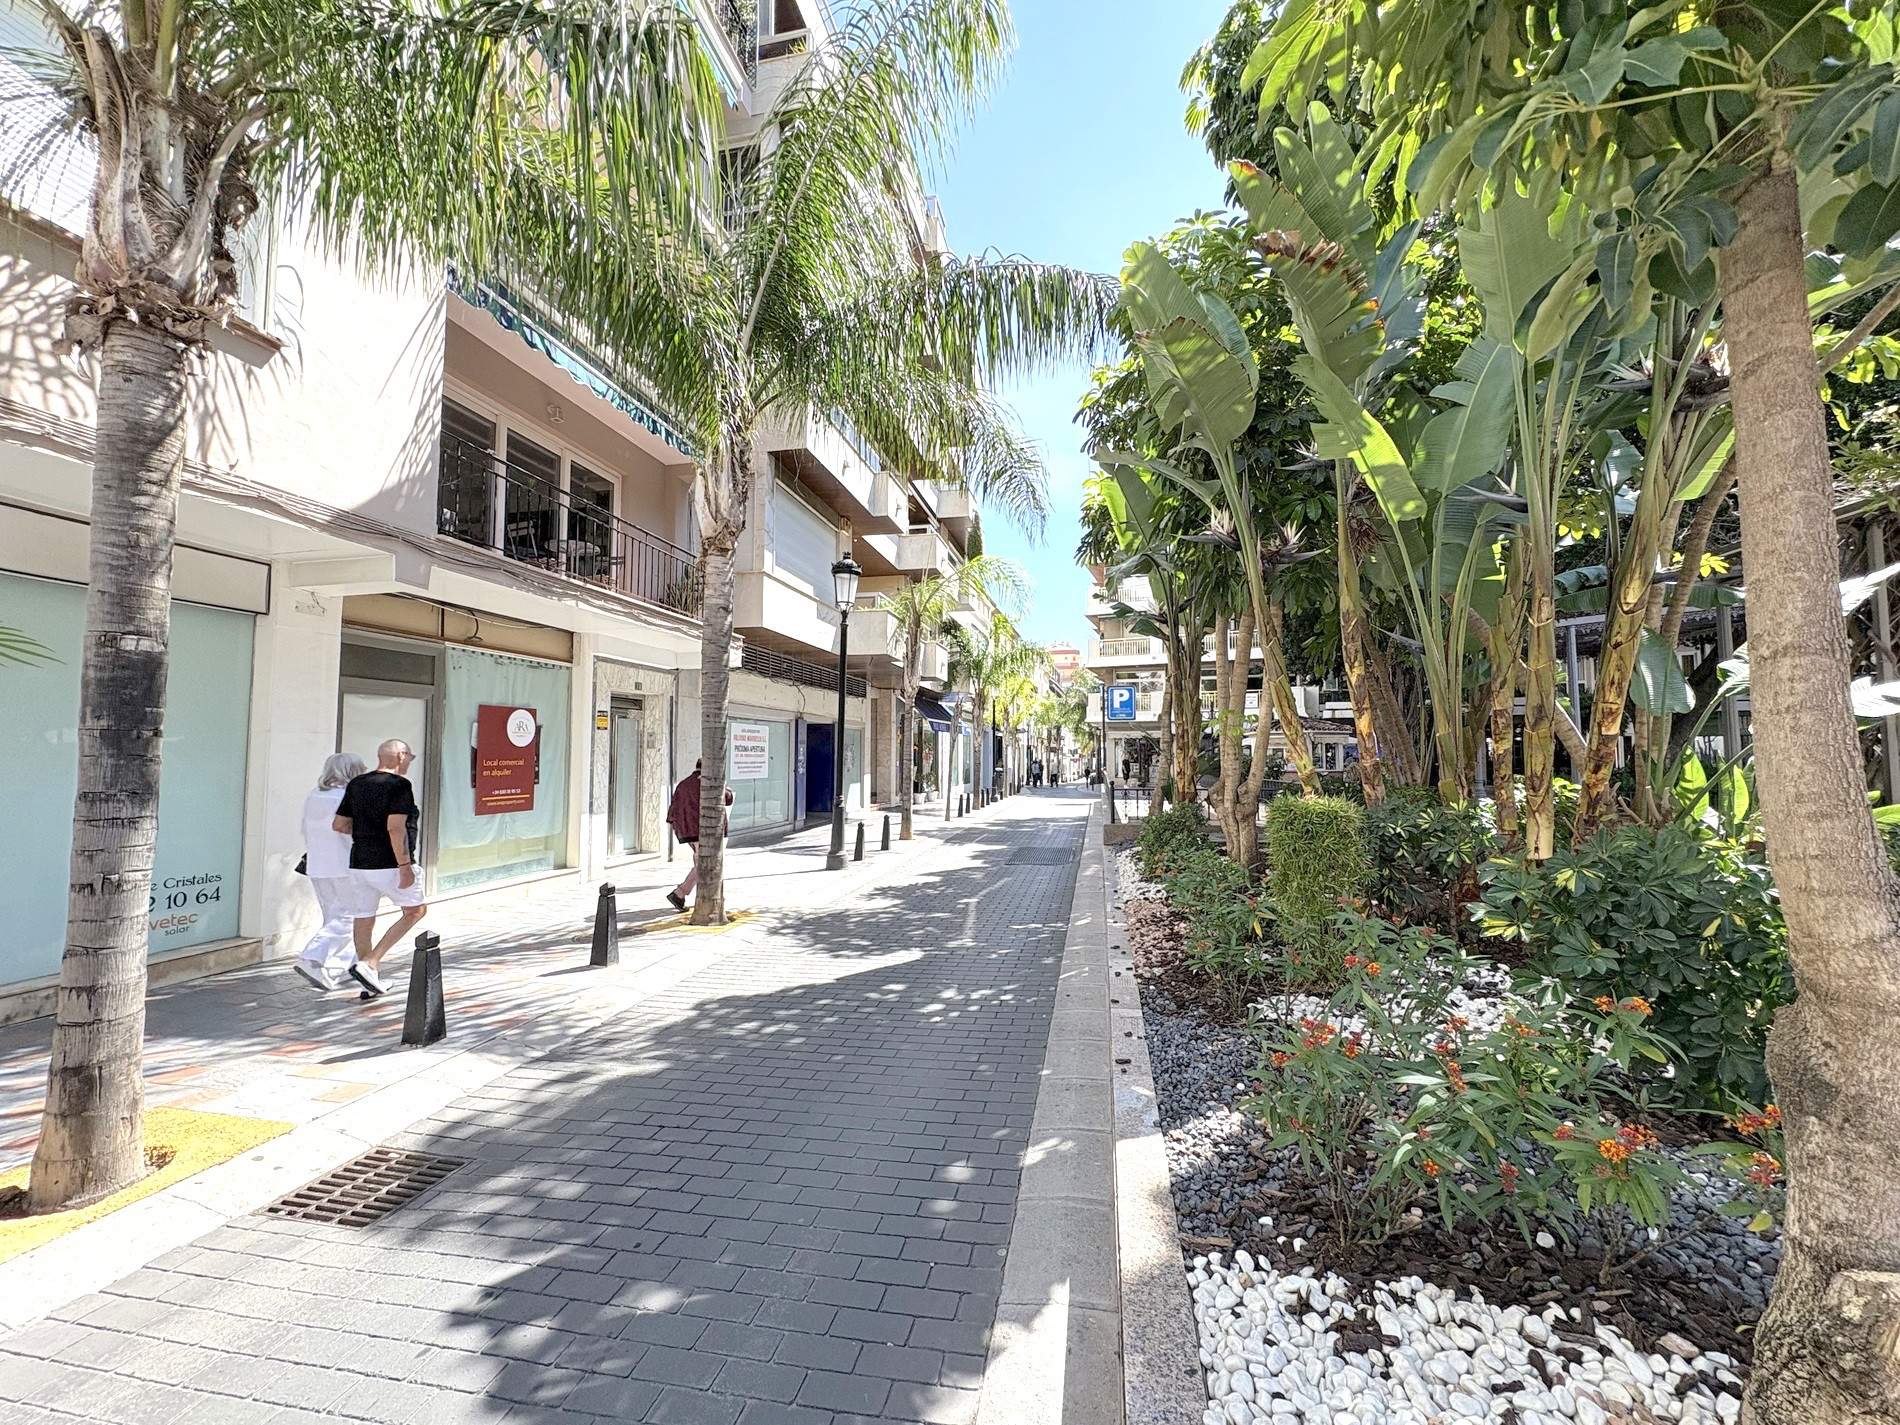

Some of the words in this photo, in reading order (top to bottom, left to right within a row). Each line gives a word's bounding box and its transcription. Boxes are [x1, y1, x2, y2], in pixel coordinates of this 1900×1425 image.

[1113, 690, 1130, 708] P
[491, 769, 512, 777] alquiler
[150, 883, 158, 892] e
[164, 873, 222, 888] Cristales
[149, 896, 156, 912] 2
[166, 892, 187, 909] 10
[196, 886, 221, 904] 64
[149, 914, 198, 930] vetec
[164, 926, 190, 936] solar
